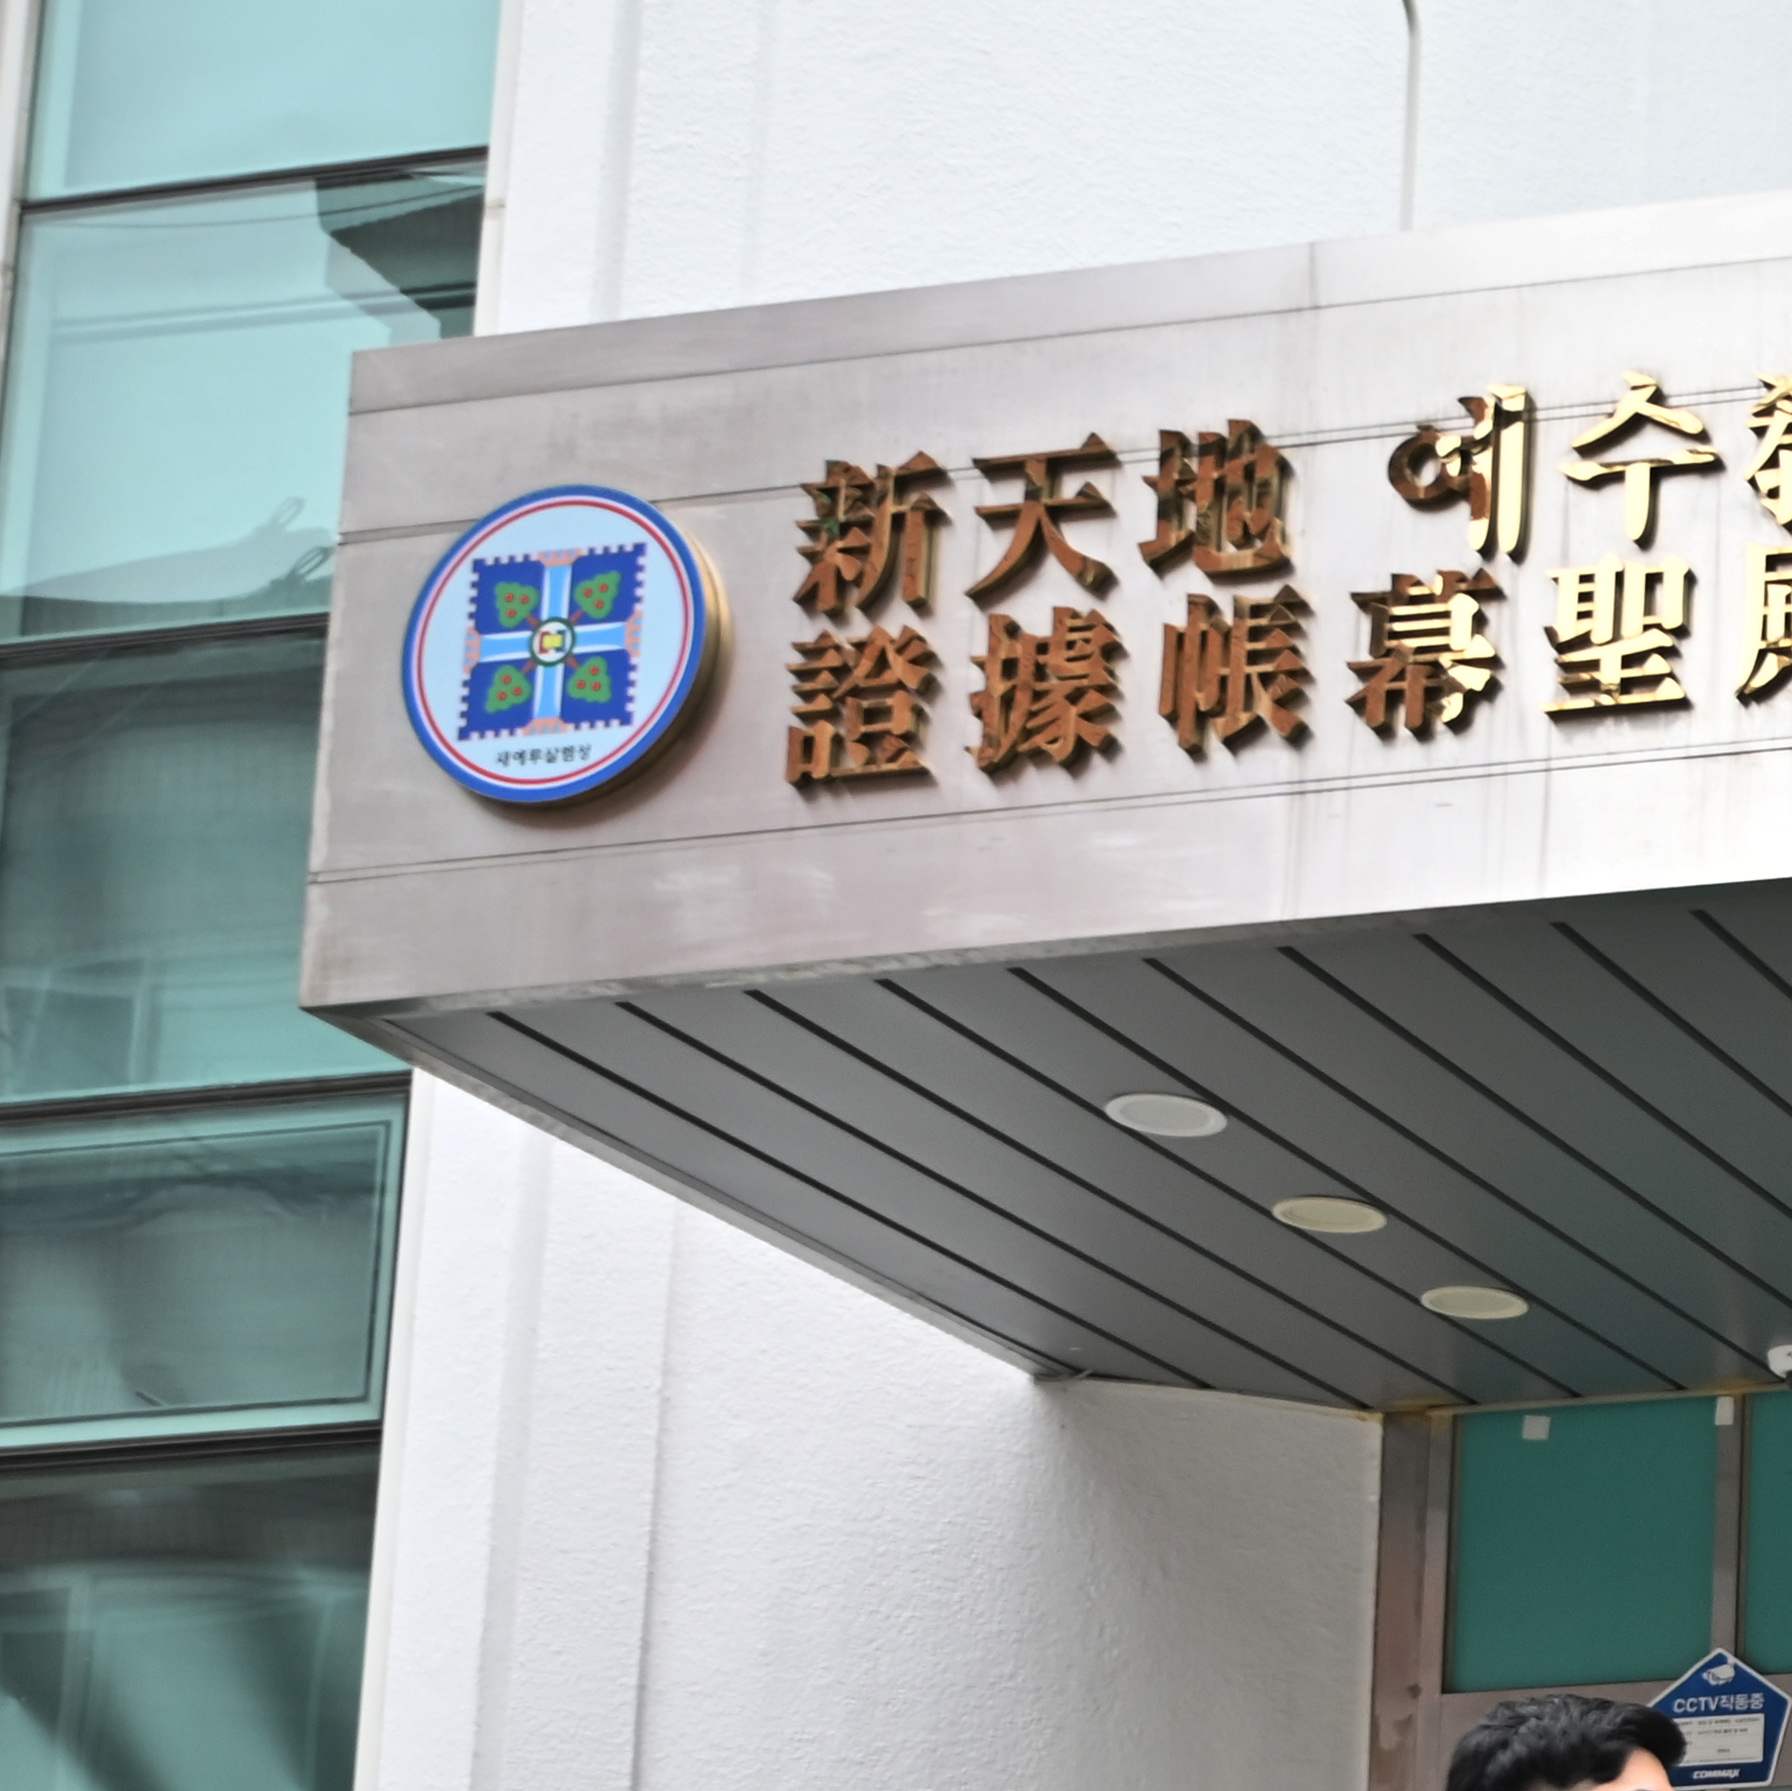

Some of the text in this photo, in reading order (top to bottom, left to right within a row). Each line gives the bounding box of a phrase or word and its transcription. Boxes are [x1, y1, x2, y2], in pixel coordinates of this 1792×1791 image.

[796, 418, 1298, 613] 新天地
[1672, 1693, 1764, 1714] CCTV작동중
